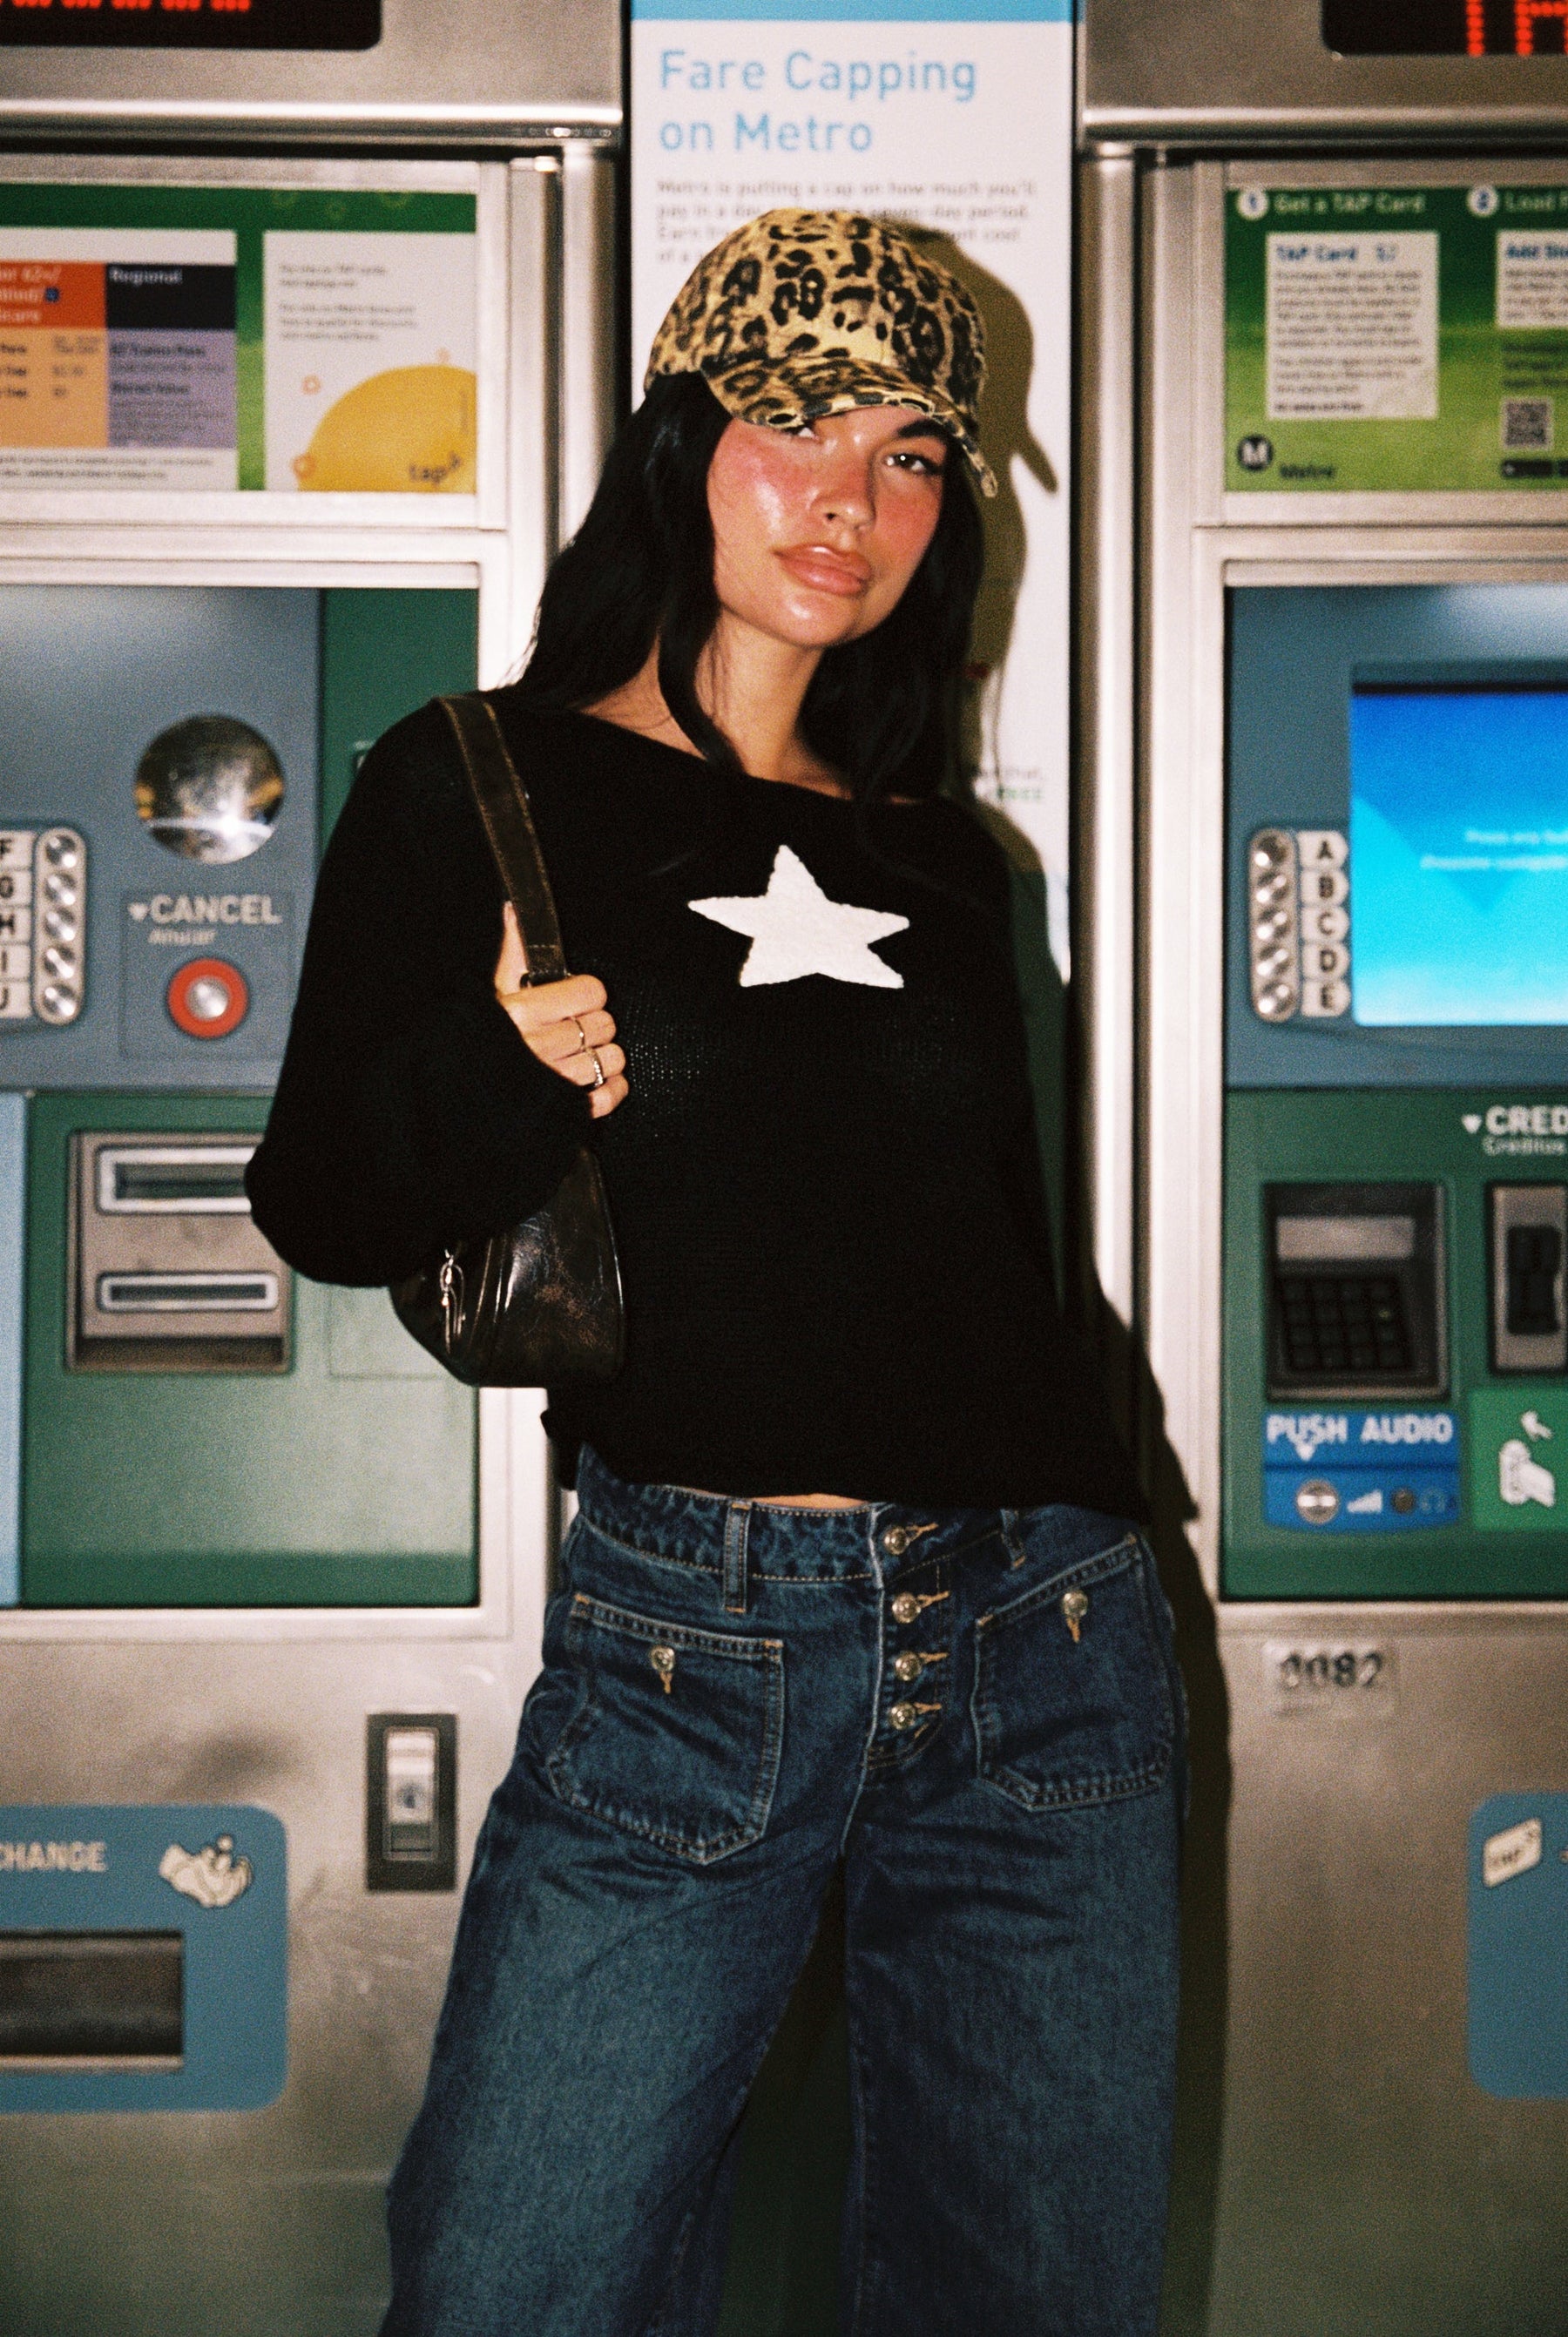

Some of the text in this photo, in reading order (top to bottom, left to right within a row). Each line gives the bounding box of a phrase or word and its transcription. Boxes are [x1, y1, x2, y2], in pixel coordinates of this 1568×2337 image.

[659, 49, 977, 102] Fare Capping
[659, 113, 873, 152] on Metro
[109, 267, 183, 287] Regional
[1317, 839, 1335, 861] A
[1319, 876, 1335, 899] B
[150, 894, 283, 925] CANCEL
[1317, 914, 1334, 936] C
[1319, 950, 1336, 973] D
[1320, 987, 1335, 1010] E
[1485, 1104, 1568, 1136] CRED
[1267, 1413, 1454, 1444] PUSH AUDIO
[0, 1841, 107, 1873] HANGE
